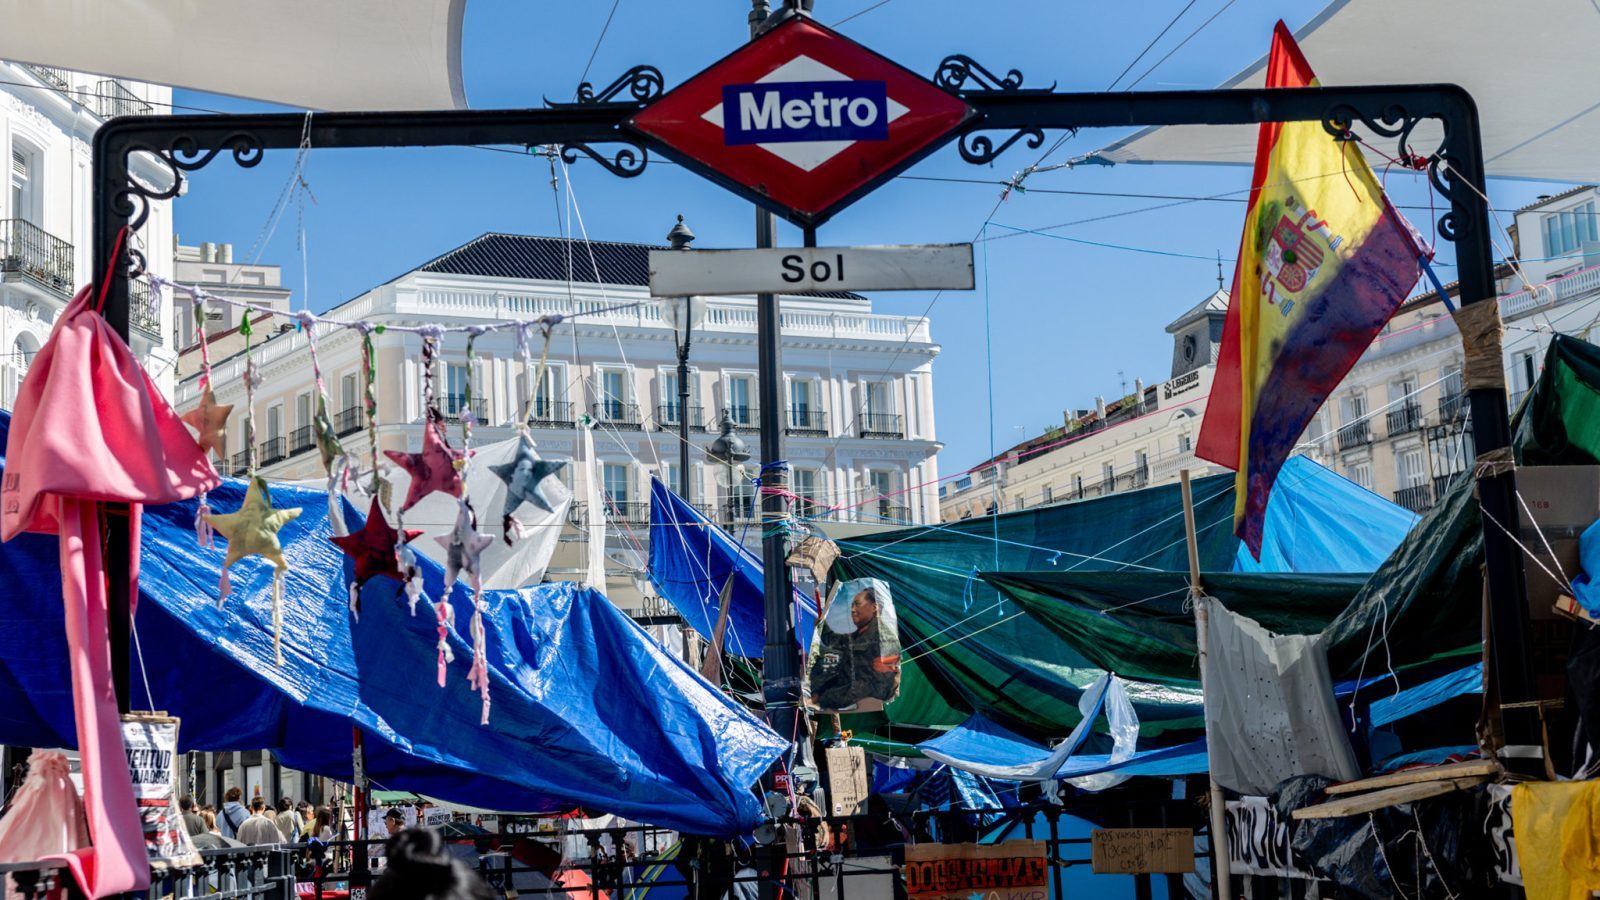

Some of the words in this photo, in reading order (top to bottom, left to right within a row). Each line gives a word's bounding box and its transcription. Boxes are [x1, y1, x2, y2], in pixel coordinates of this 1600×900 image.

[739, 91, 878, 131] Metro
[781, 254, 844, 283] Sol
[125, 749, 171, 769] VENTUD
